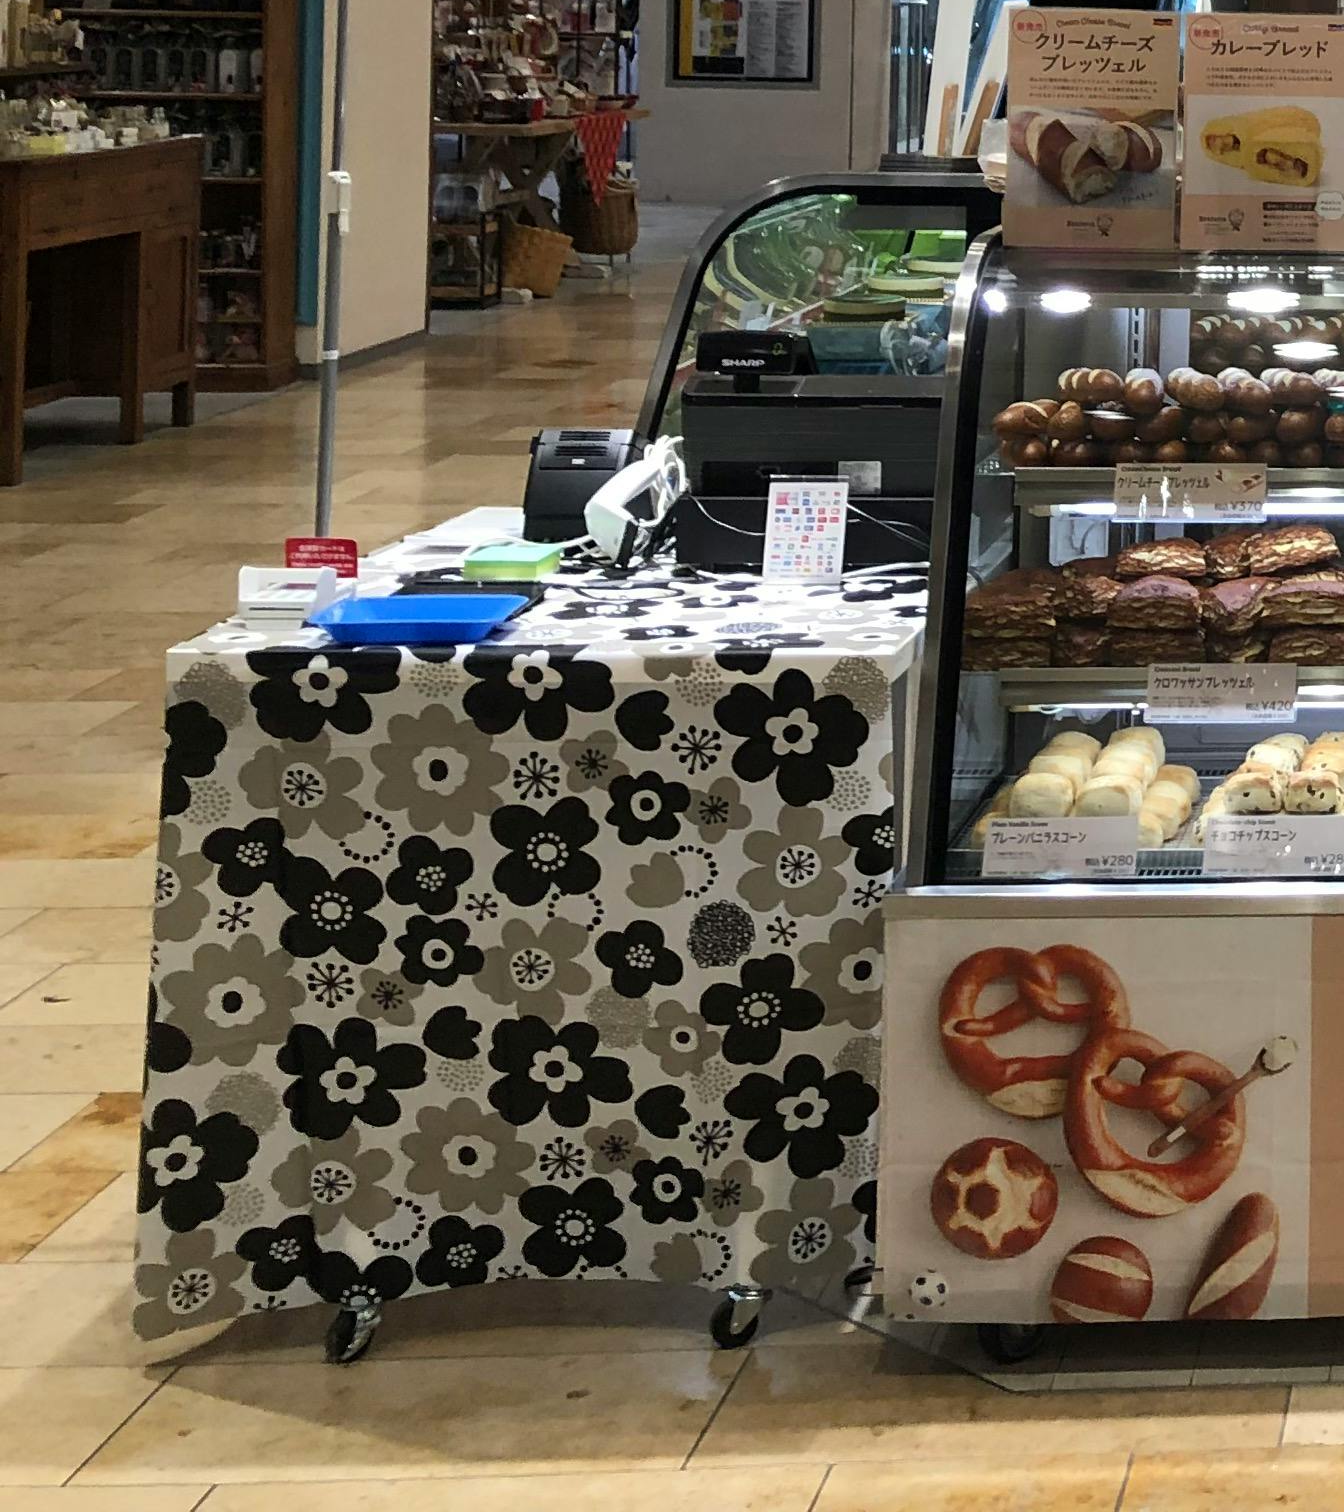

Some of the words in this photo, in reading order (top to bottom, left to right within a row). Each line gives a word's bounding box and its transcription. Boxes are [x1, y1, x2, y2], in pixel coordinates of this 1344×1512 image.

[1035, 33, 1155, 52] クリームチーズ
[1211, 39, 1329, 58] カレーブレッド
[1042, 54, 1147, 73] ブレッツェル
[1261, 701, 1292, 712] ¥420
[1101, 855, 1133, 866] ¥280
